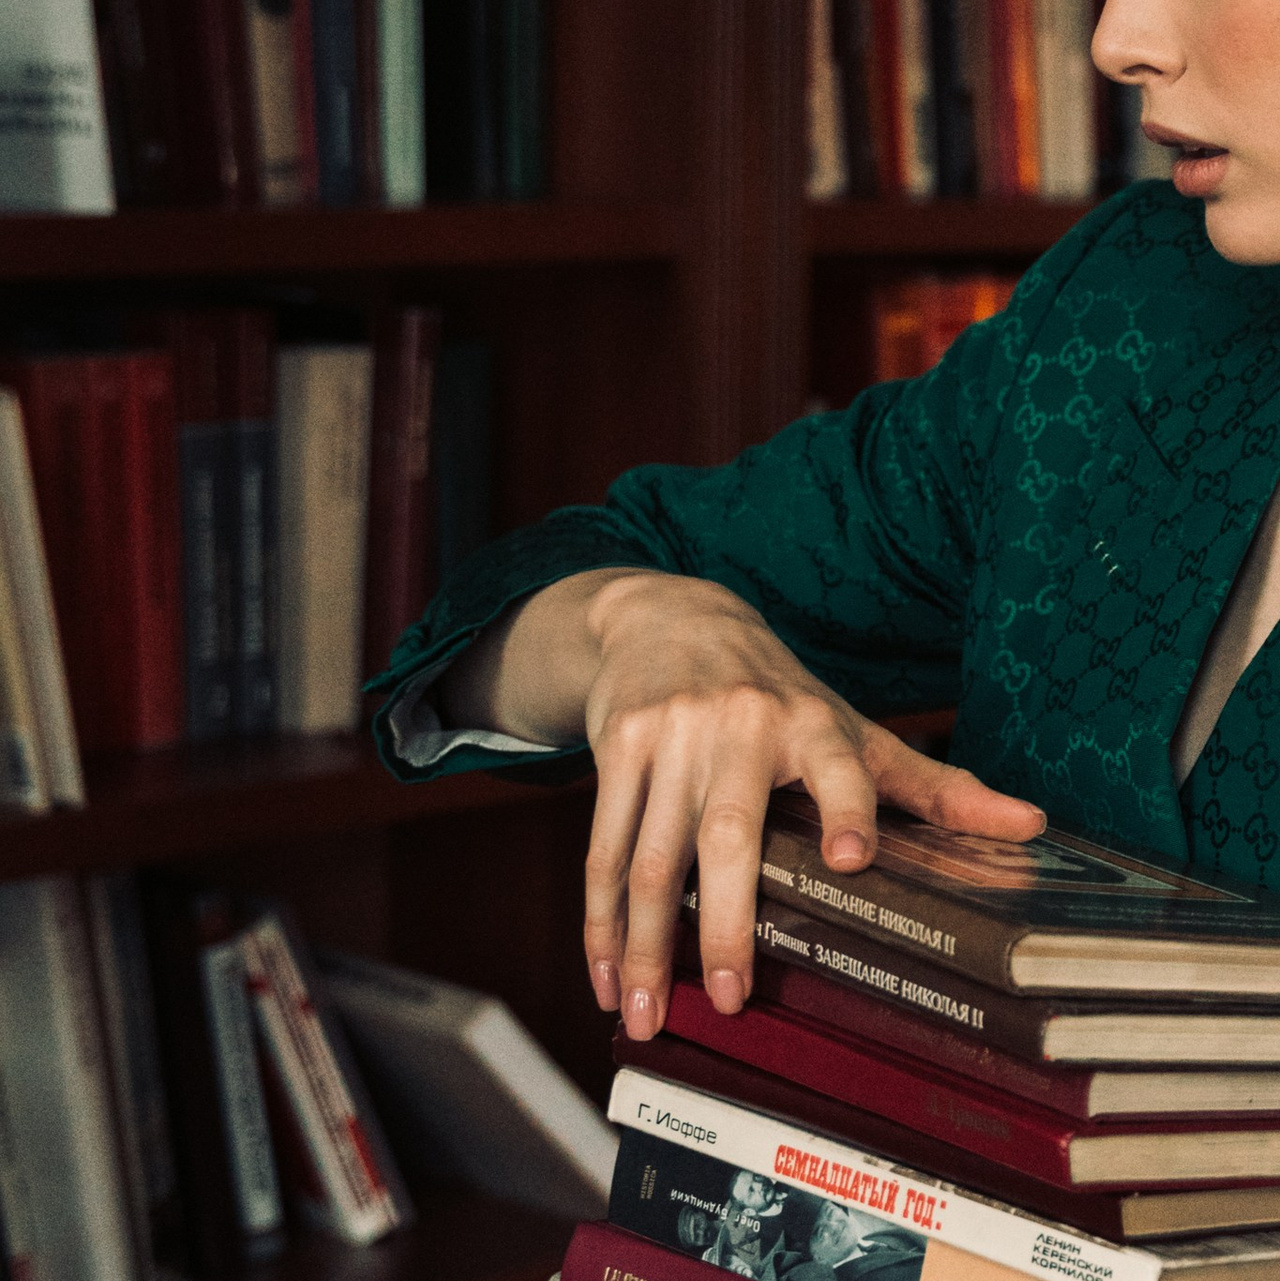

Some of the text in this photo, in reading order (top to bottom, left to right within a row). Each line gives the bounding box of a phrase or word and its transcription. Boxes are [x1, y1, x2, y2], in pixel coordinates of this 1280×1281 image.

[761, 862, 795, 888] янник
[798, 873, 877, 923] ЗАВЕЩАНИЕ
[878, 907, 943, 951] НИКОЛАЯ
[764, 921, 811, 957] Грянник
[814, 943, 900, 995] ЗАВЕЩАНИЕ
[901, 979, 970, 1024] НИКОЛАЯ
[656, 1109, 718, 1145] Иоффе
[773, 1144, 900, 1215] СЕМНАДЦАТЫЙ
[670, 1188, 761, 1233] Олег Будницкий
[1032, 1243, 1114, 1278] КЕРЕНСКИЙ
[1036, 1232, 1082, 1255] ЛЕНИН
